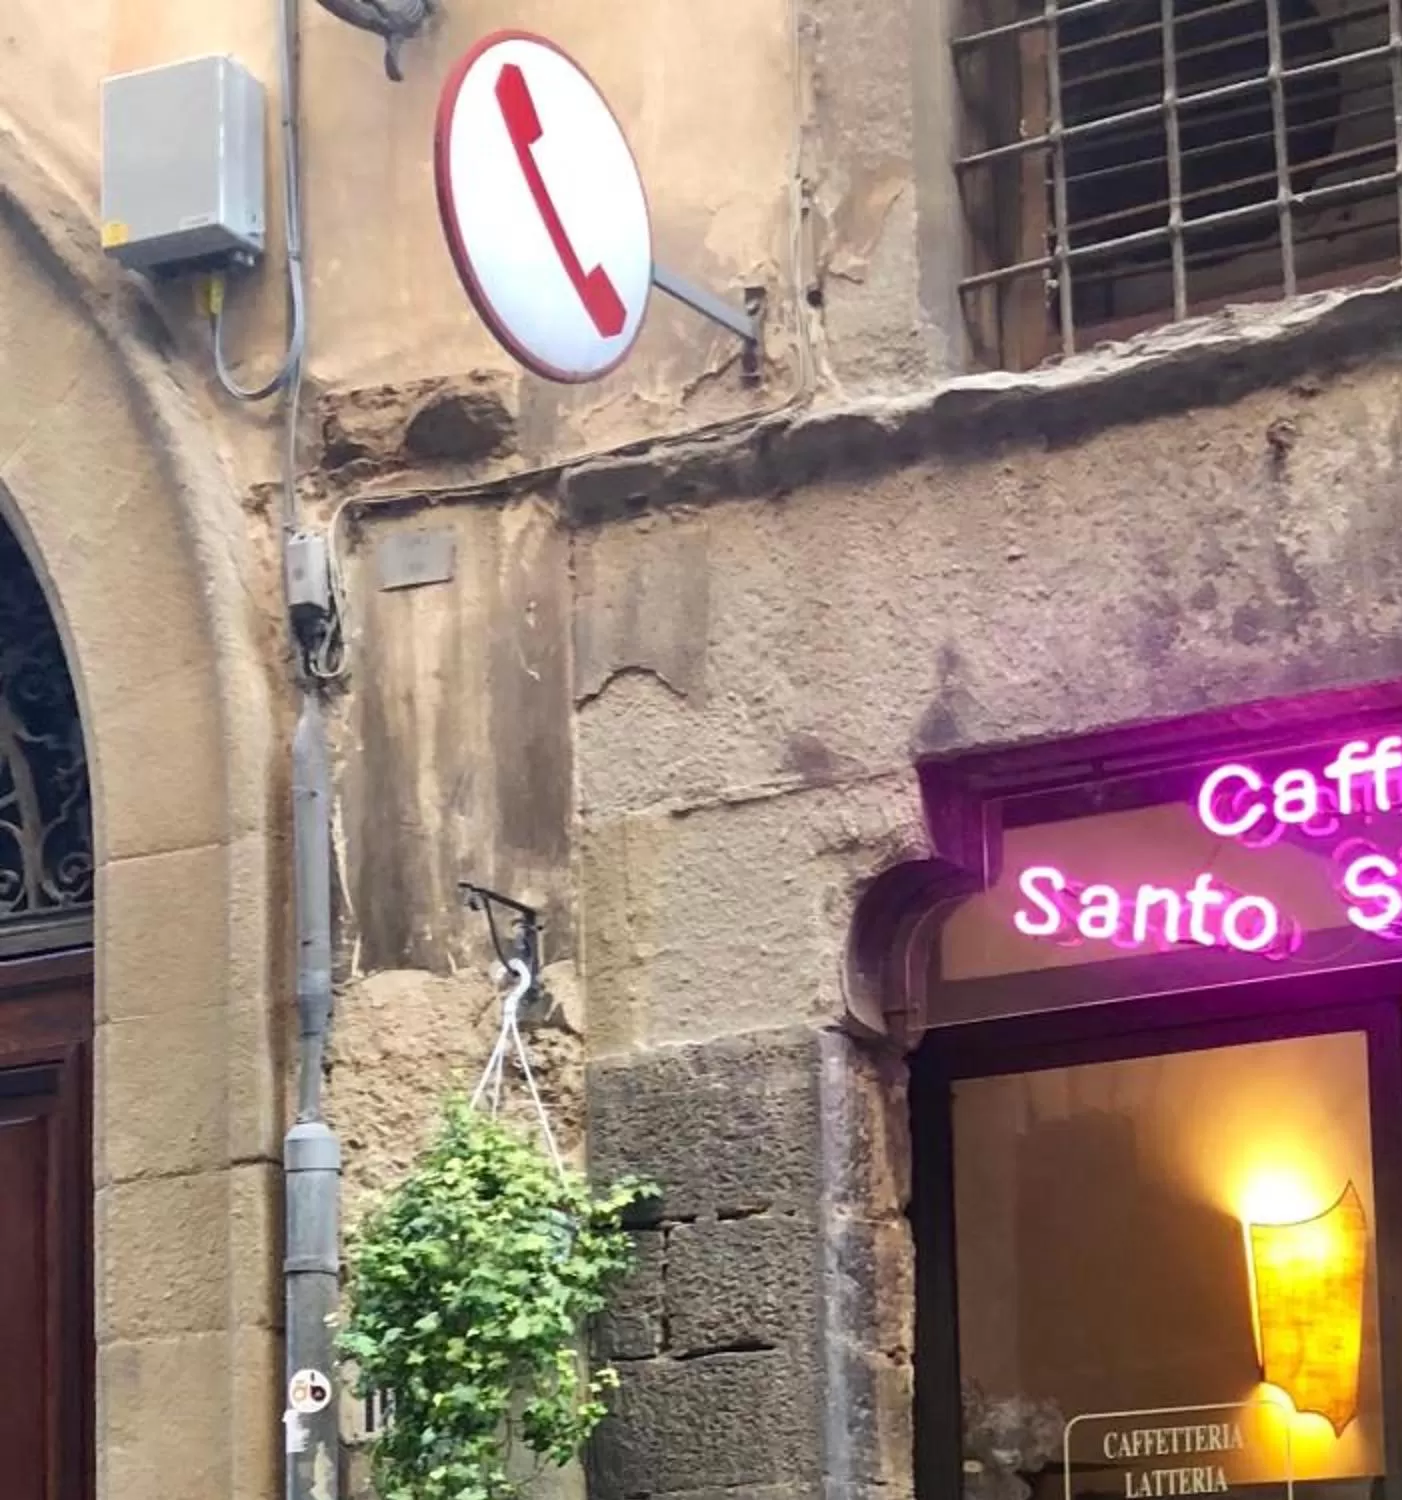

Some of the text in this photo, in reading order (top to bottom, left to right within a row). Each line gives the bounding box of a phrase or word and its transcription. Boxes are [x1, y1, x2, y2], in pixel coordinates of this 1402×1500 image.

[1013, 866, 1279, 952] Santo
[1103, 1423, 1243, 1459] CAFFETTERIA
[1125, 1466, 1228, 1499] LATTERIA
